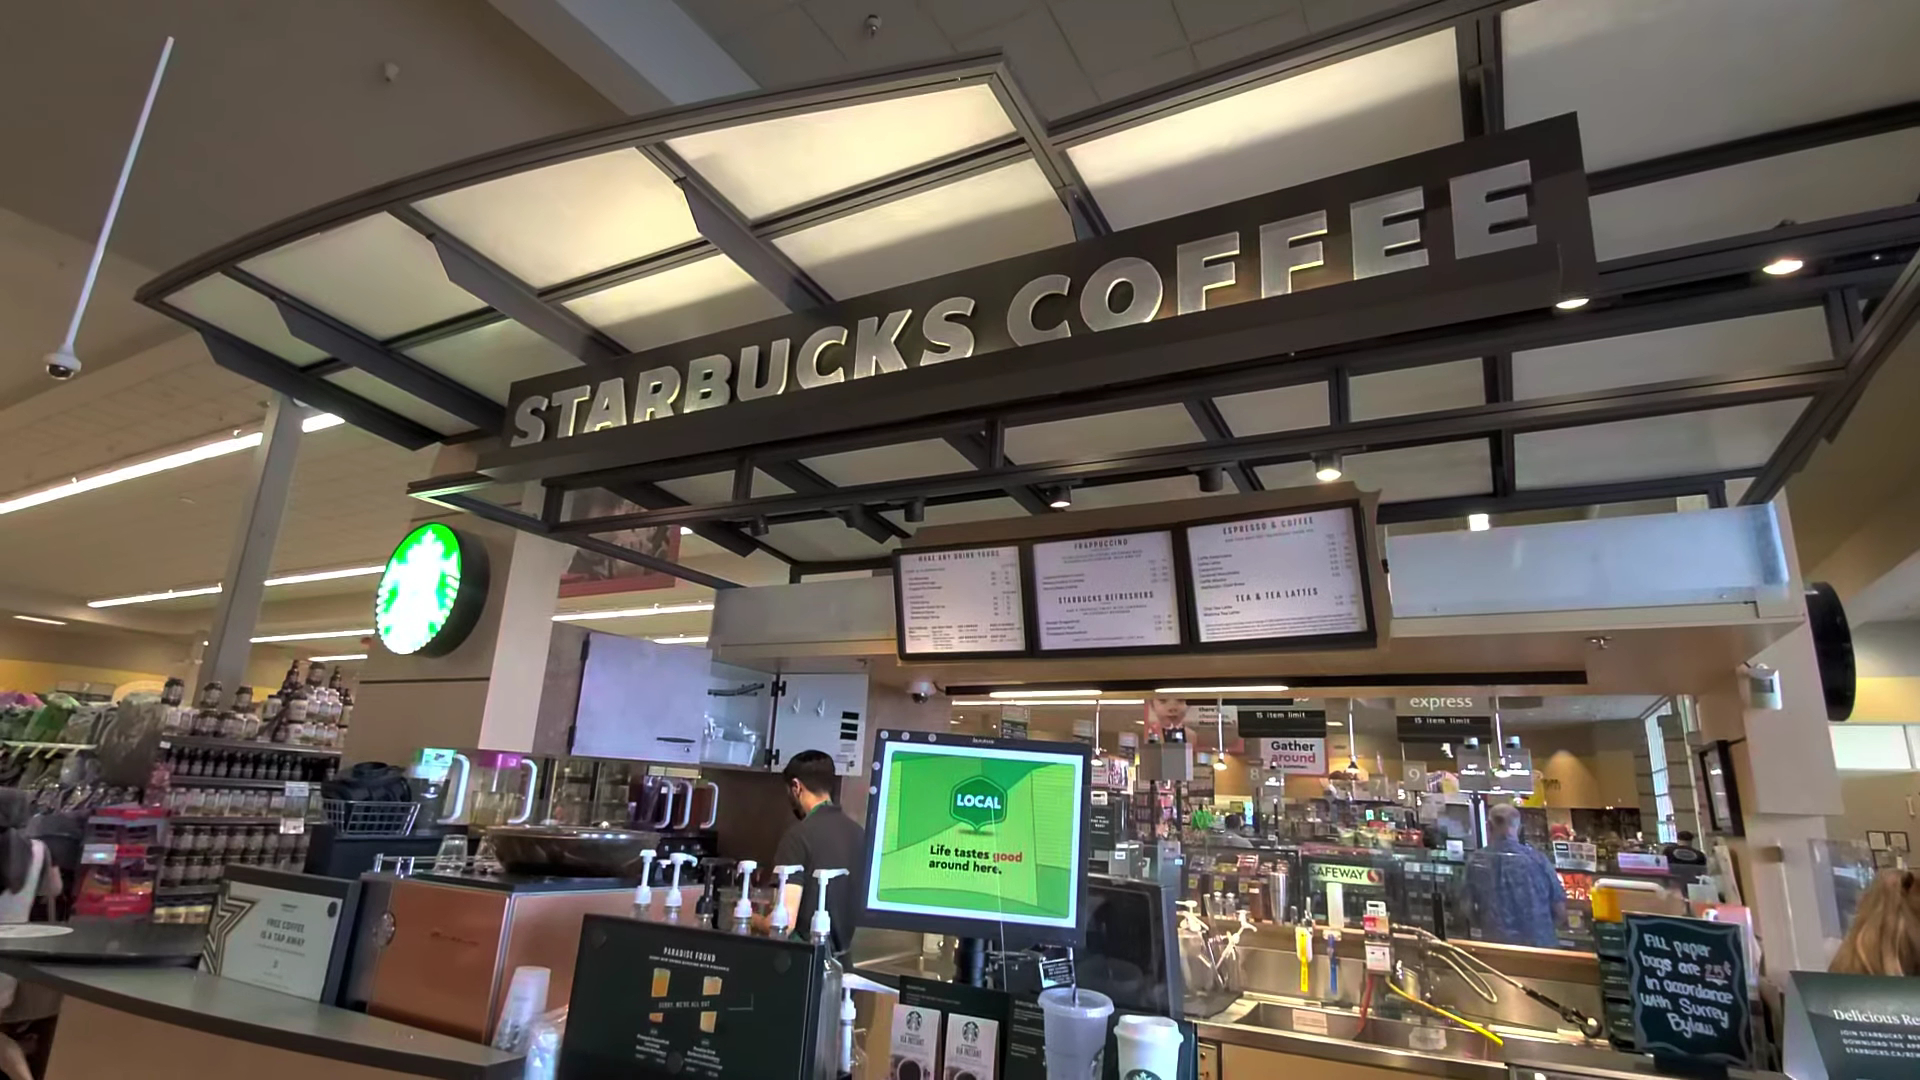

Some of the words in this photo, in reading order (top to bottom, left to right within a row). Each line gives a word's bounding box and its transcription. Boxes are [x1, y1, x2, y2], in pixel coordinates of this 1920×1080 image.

[509, 295, 976, 448] STARBUCKS
[1006, 158, 1538, 349] COFFEE
[1223, 521, 1267, 535] ESPRESSO
[1281, 516, 1314, 528] COFFEE
[1074, 538, 1128, 550] FRAPPUCCINO
[1058, 594, 1102, 604] STARBUCKS
[1236, 592, 1252, 603] TEA
[1265, 590, 1281, 600] TEA
[1285, 587, 1318, 598] LATTES
[1410, 696, 1473, 711] express
[1271, 739, 1315, 752] Gather
[1271, 753, 1316, 764] around
[1250, 768, 1259, 780] 8
[1409, 768, 1420, 782] 9
[956, 793, 1001, 809] LOCAL
[930, 844, 951, 857] Life
[954, 847, 990, 860] tastes
[992, 852, 1022, 864] good
[929, 860, 969, 872] around
[973, 862, 1002, 874] here.
[1310, 866, 1365, 880] SAFEWAY
[282, 920, 305, 933] COFFEE
[663, 946, 694, 960] PARADISE
[695, 951, 716, 963] FOUND
[1673, 941, 1711, 960] paper
[1639, 951, 1673, 977] bags
[1678, 965, 1700, 976] are
[1664, 981, 1733, 1004] accordance
[1640, 993, 1672, 1010] with
[1679, 999, 1729, 1029] Surrey
[1833, 1009, 1900, 1025] Delicious
[1667, 1012, 1718, 1038] Bylaw.
[1840, 1029, 1857, 1037] JOIN
[1843, 1038, 1888, 1048] DOWNLOAD
[1889, 1041, 1905, 1049] THE
